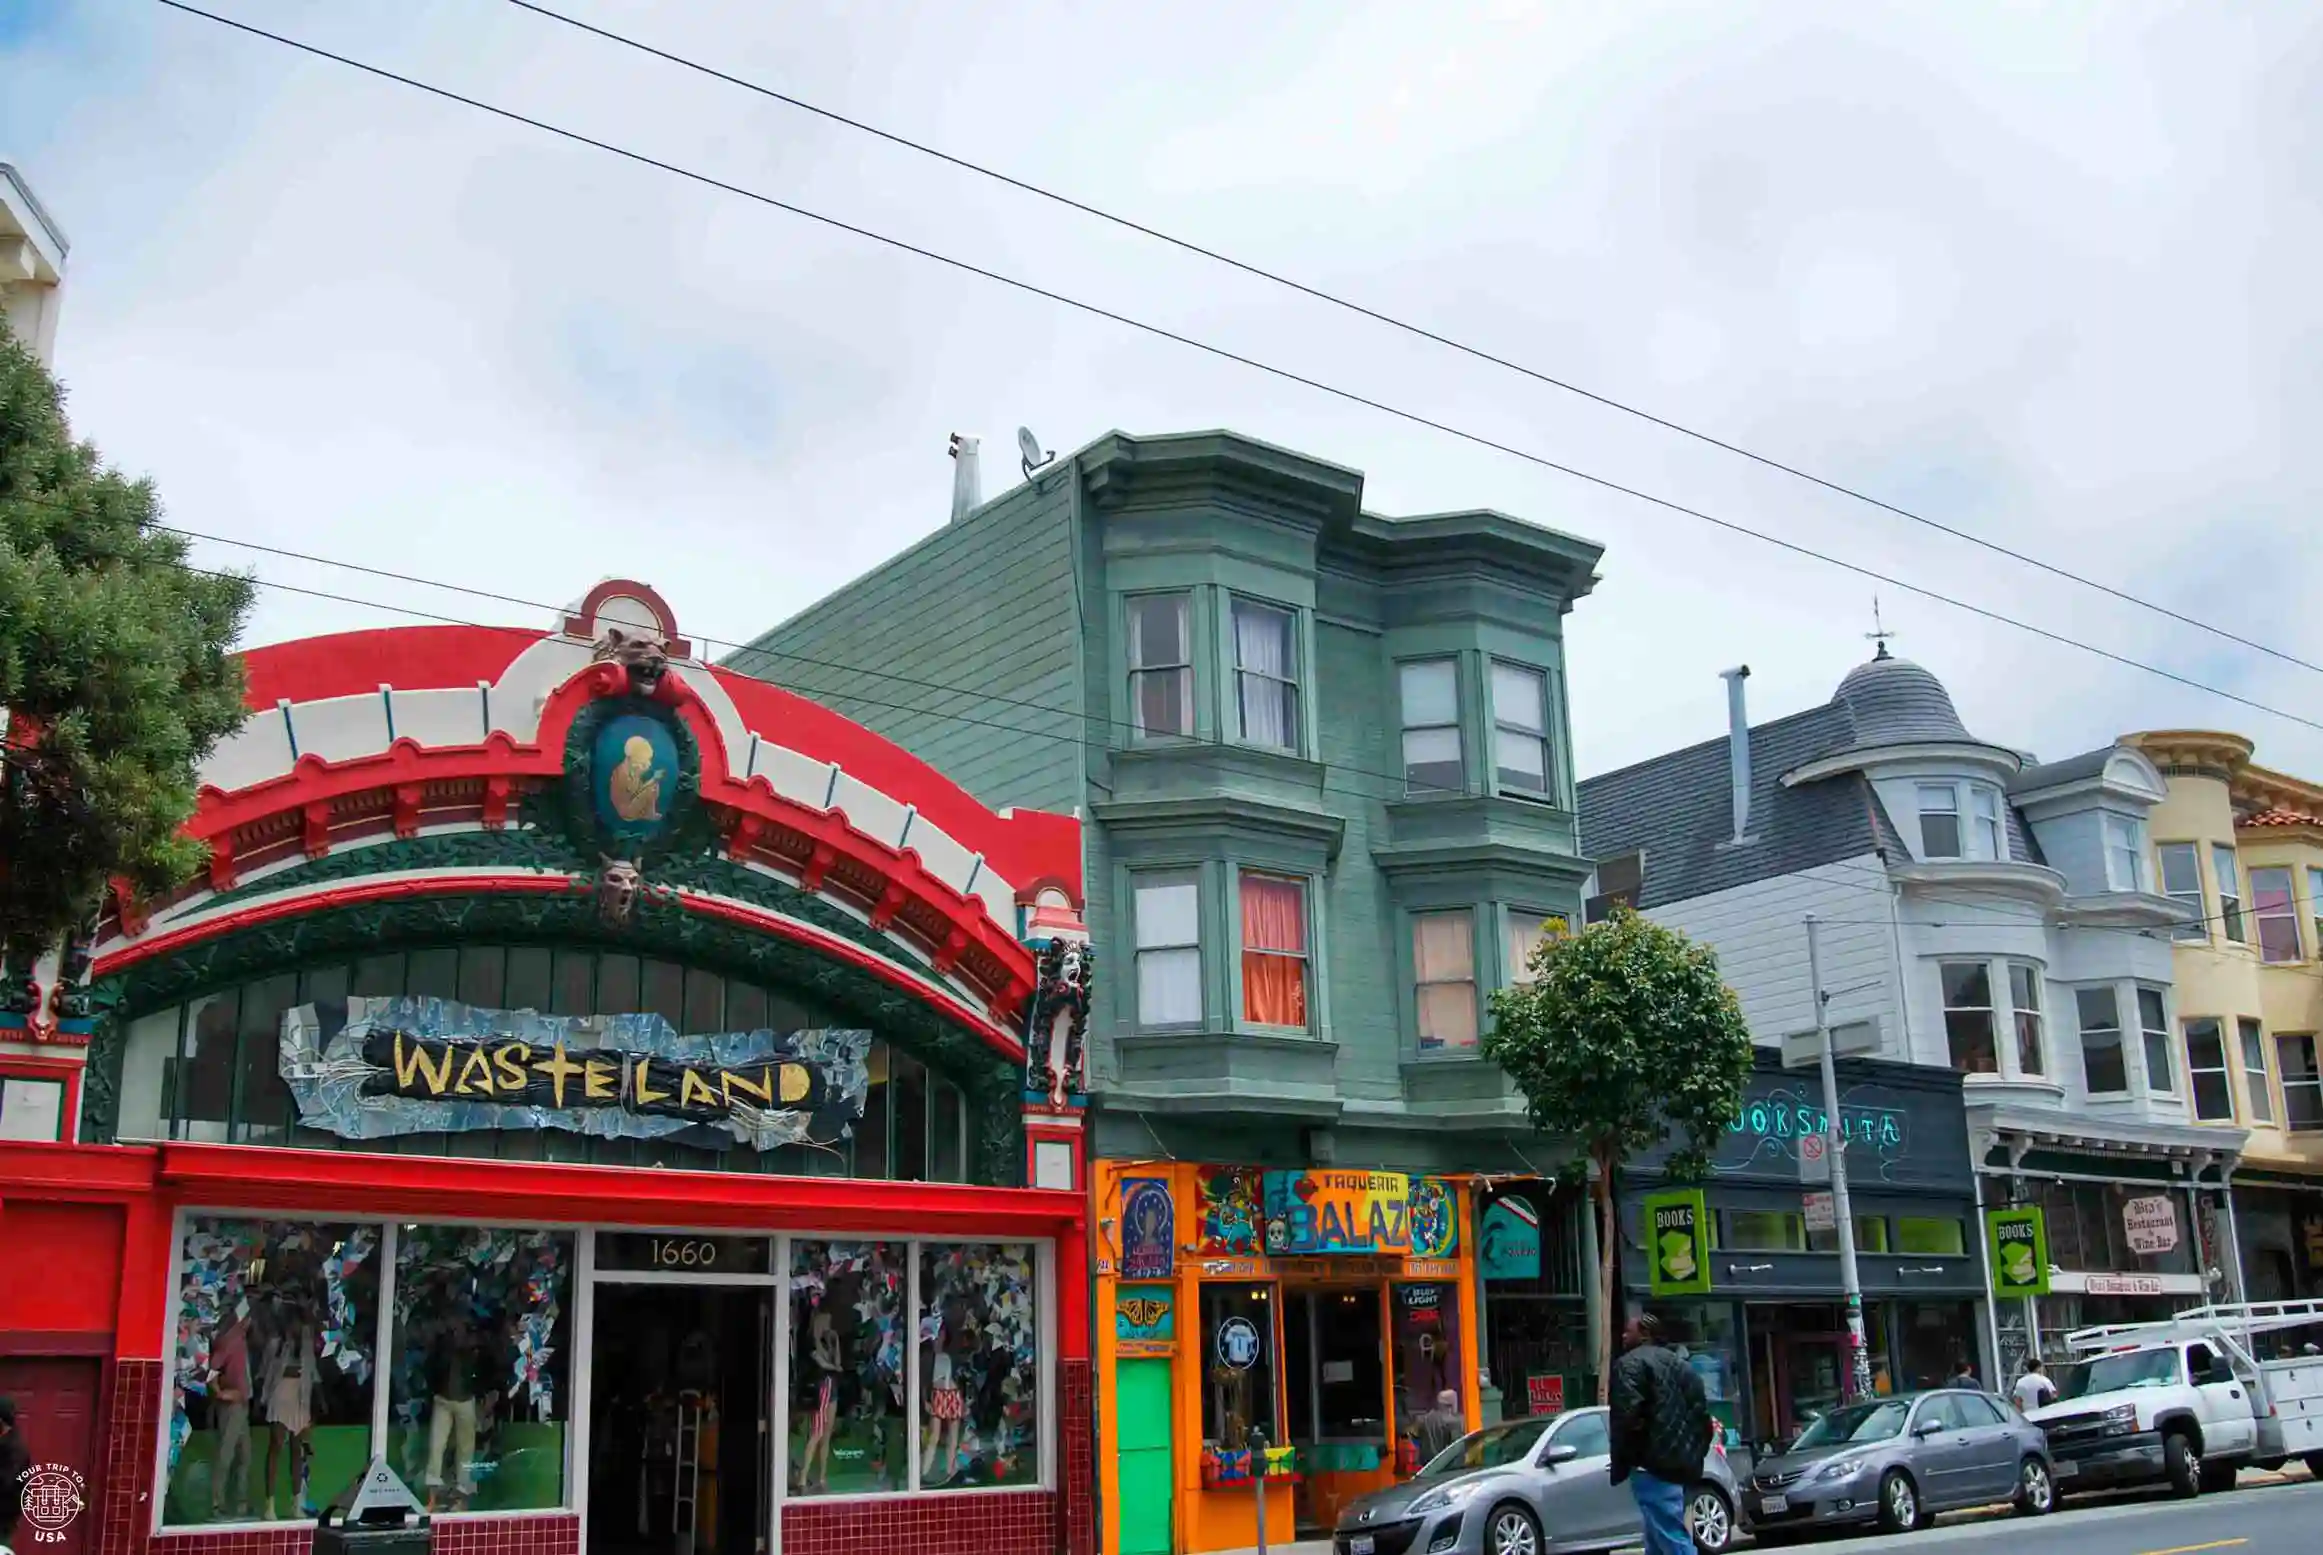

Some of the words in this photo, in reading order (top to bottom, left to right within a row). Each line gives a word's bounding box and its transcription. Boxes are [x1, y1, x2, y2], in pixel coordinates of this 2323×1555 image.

[394, 1031, 810, 1110] WASTELAND
[1656, 1208, 1695, 1229] BOOKS
[2127, 1216, 2174, 1231] Restaurant
[1998, 1222, 2034, 1240] BOOKS
[651, 1238, 717, 1266] 1660
[2133, 1237, 2156, 1250] Wine
